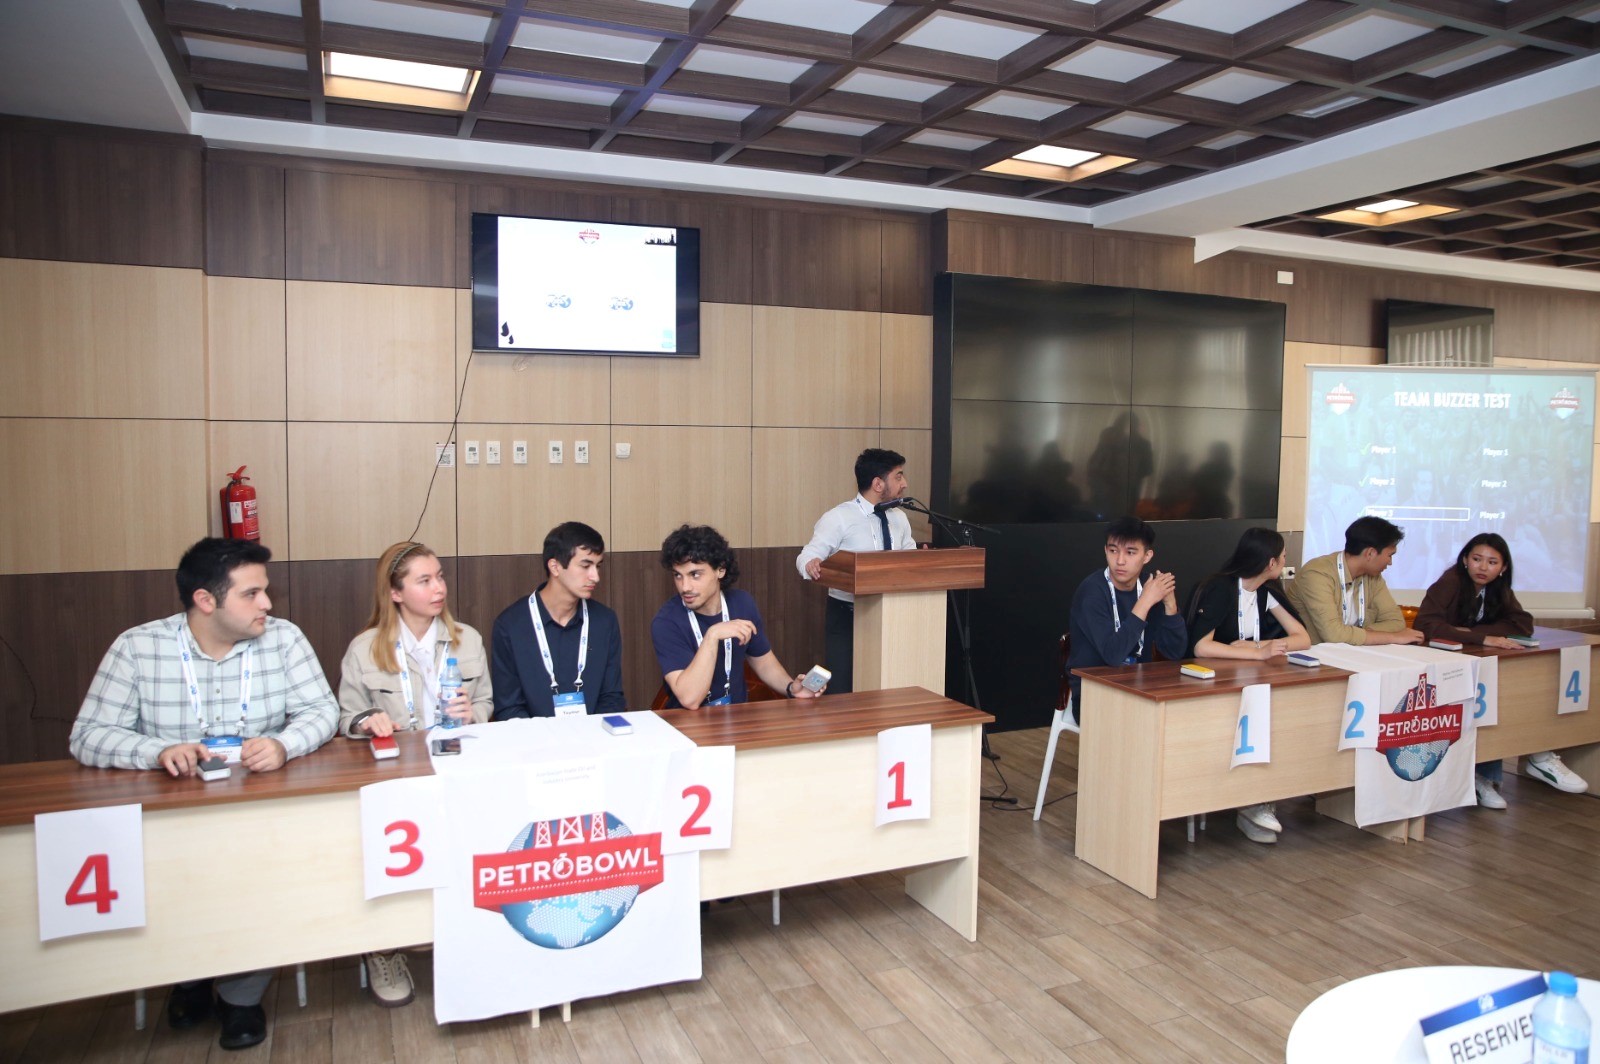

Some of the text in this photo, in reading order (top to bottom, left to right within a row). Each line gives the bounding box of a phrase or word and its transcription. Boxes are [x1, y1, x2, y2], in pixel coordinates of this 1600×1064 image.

[1394, 391, 1511, 409] TEAM BUZZER TEST
[1371, 445, 1391, 455] Player
[1483, 447, 1509, 457] Player 1
[1369, 477, 1395, 487] Player 2
[1481, 479, 1508, 488] Player 2
[1479, 511, 1505, 520] Player 3
[1474, 682, 1486, 719] 3
[1565, 670, 1581, 703] 4
[1235, 714, 1255, 756] 1
[1345, 700, 1365, 739] 2
[1379, 714, 1460, 737] PETROBOWL
[887, 761, 912, 809] 1
[679, 785, 711, 838] 2
[384, 820, 424, 877] 3
[65, 854, 118, 914] 4
[478, 846, 659, 889] PETROBOWL
